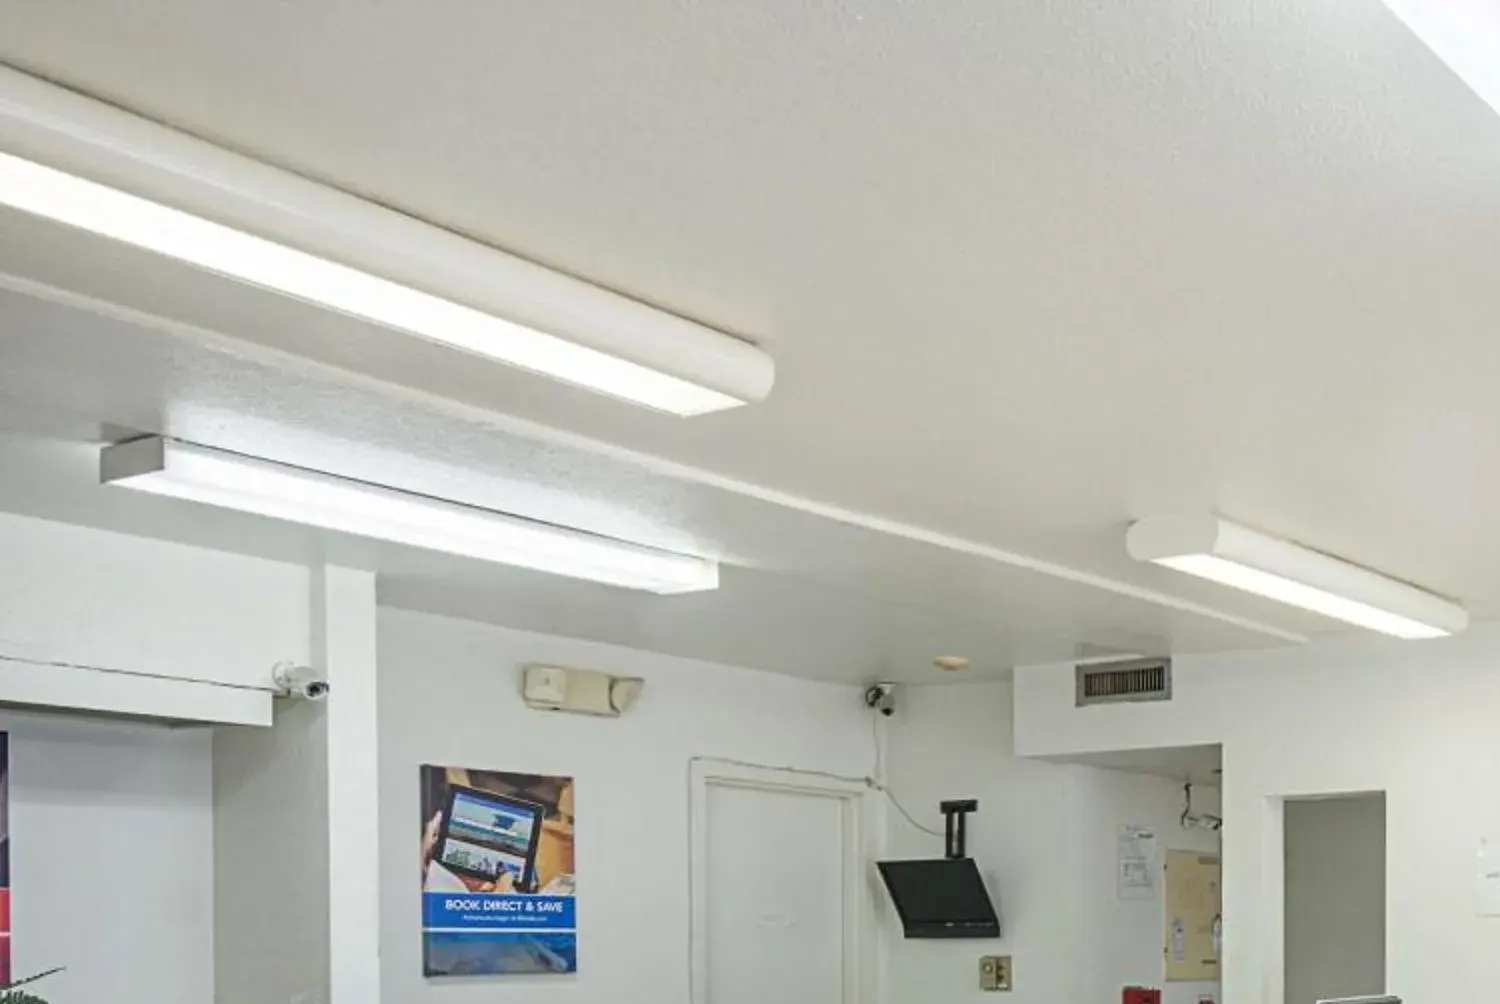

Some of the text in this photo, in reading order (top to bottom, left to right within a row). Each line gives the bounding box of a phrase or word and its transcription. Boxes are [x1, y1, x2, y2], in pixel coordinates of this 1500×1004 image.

[445, 899, 563, 913] BOOK DIRECT & SAVE
